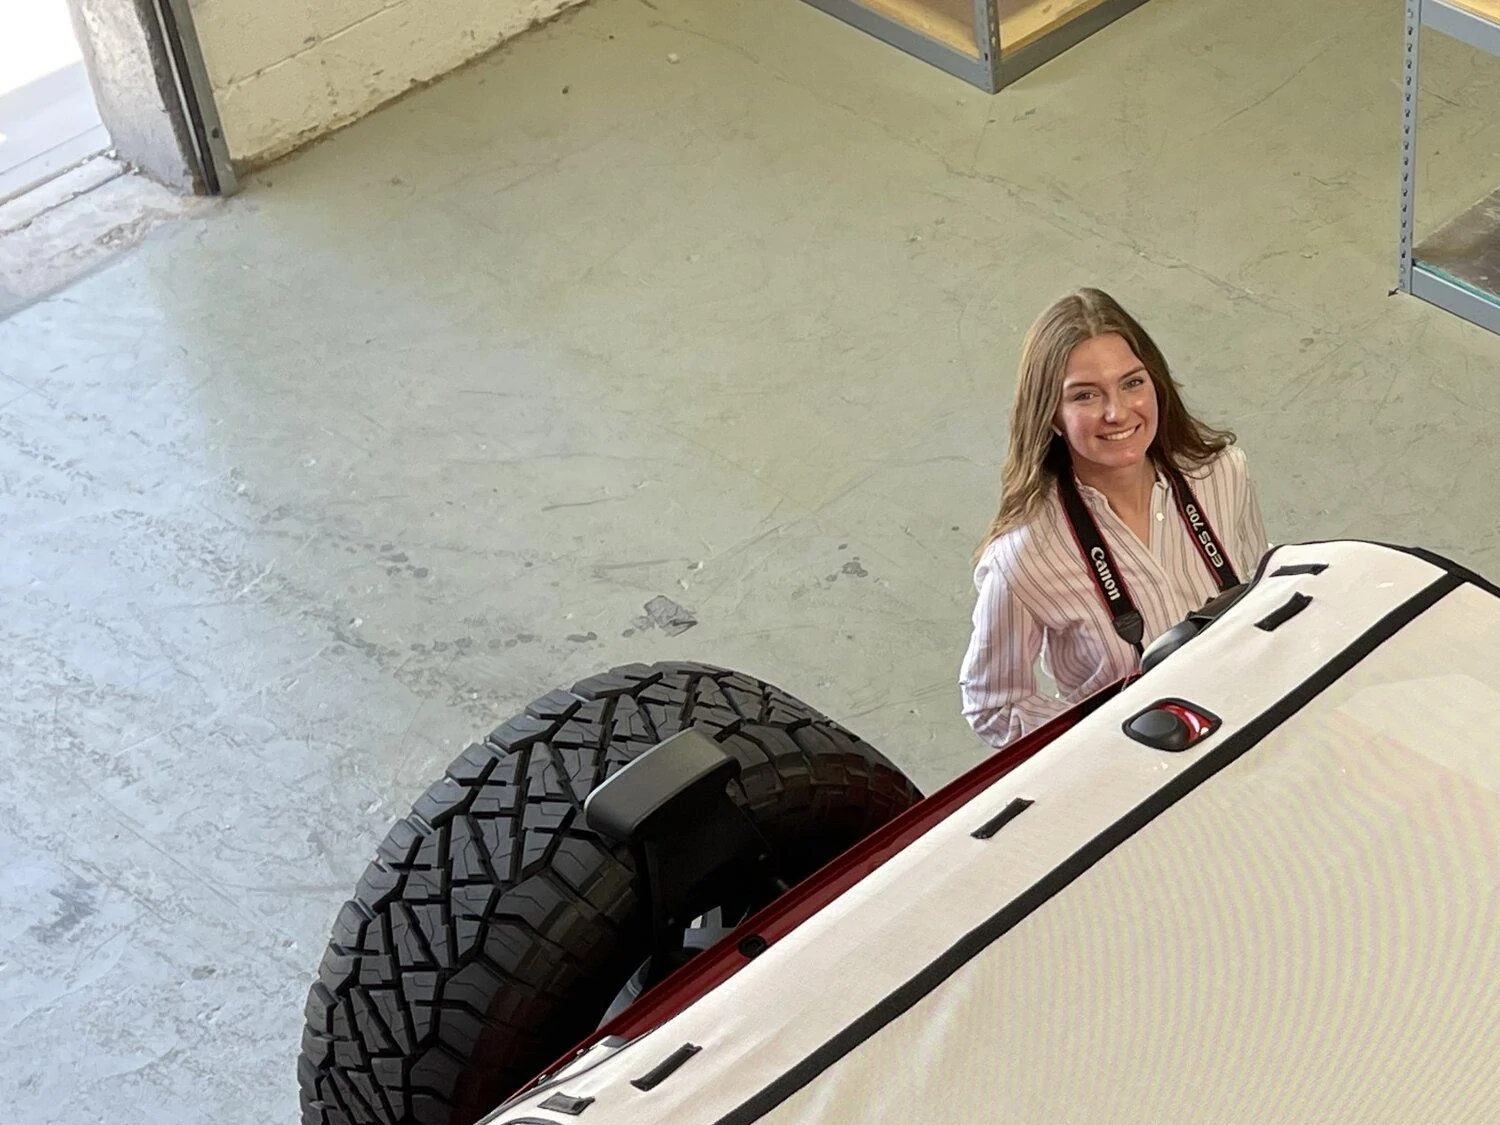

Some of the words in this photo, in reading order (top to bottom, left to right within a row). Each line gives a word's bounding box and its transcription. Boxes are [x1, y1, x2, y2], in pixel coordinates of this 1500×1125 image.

[1186, 504, 1204, 531] 70D
[1198, 531, 1224, 568] EOS
[1091, 547, 1120, 601] Canon
